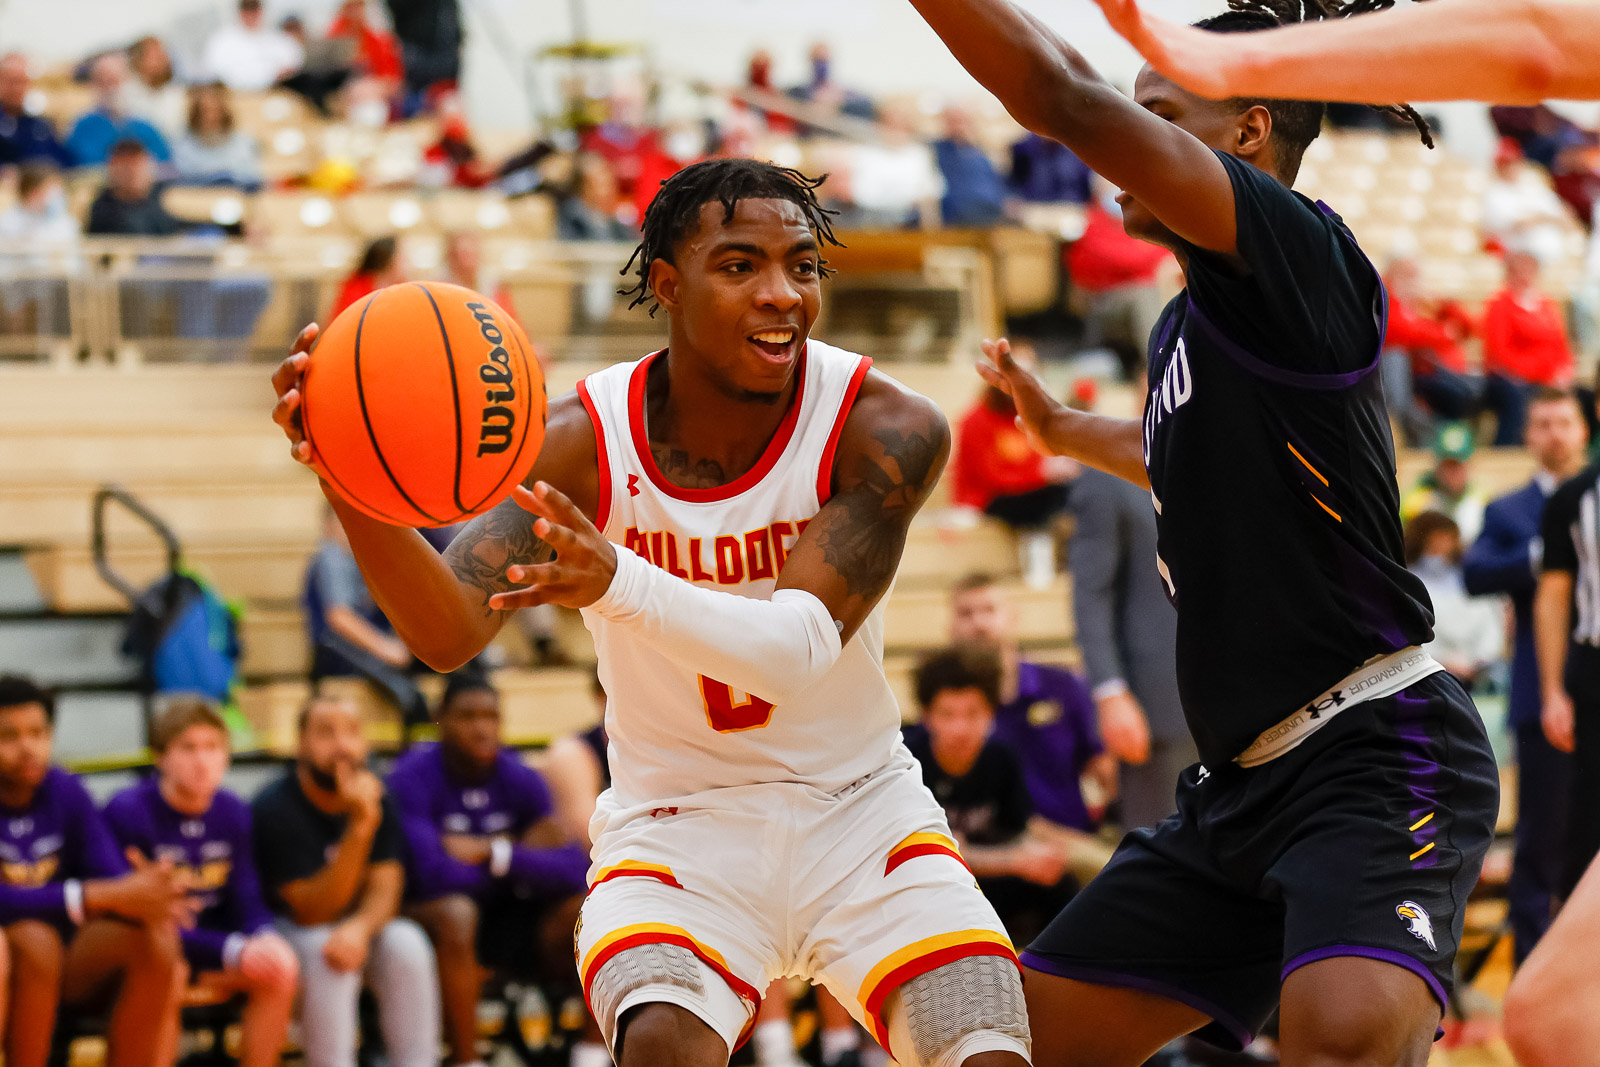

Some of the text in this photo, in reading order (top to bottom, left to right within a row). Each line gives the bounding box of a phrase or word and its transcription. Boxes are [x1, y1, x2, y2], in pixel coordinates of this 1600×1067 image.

[466, 302, 515, 458] Wilson
[624, 517, 813, 585] ULLDOG
[1349, 663, 1403, 695] ARMOUR
[1263, 715, 1305, 744] UNDER
